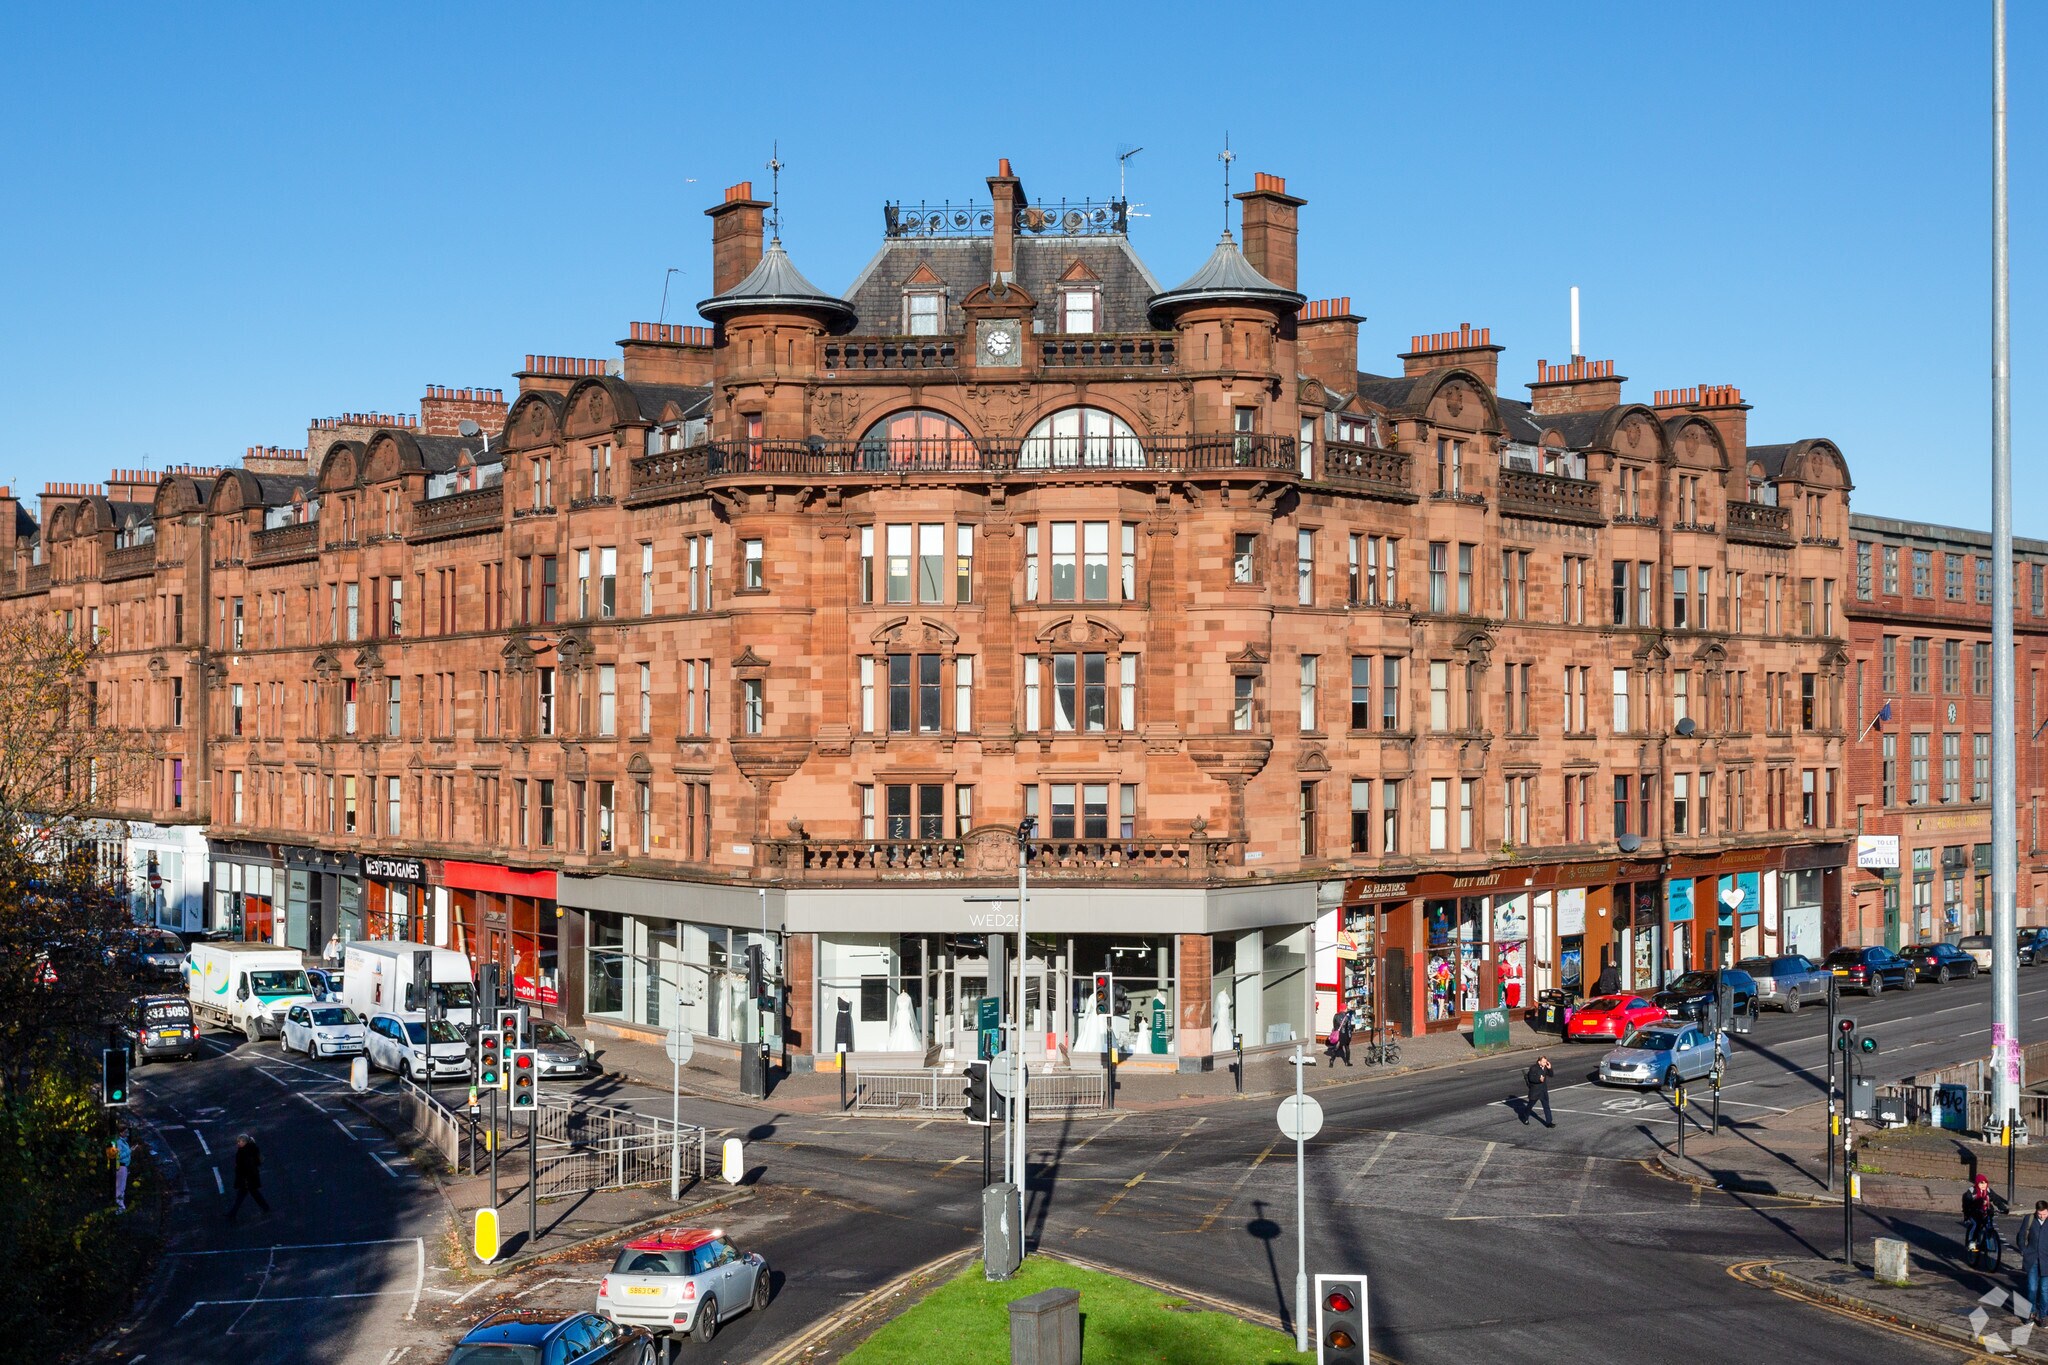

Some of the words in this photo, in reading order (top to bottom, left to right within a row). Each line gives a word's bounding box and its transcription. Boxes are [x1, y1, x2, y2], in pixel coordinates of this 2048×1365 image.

[365, 859, 382, 876] WEST
[383, 861, 397, 877] END
[396, 862, 419, 880] GAMES
[1577, 866, 1589, 874] CITY
[1589, 864, 1610, 873] GARDEN
[1453, 877, 1475, 888] ARTY
[1475, 874, 1501, 886] PARTY
[1362, 884, 1373, 894] AS
[1373, 882, 1406, 893] ELECTRICS
[630, 1287, 646, 1295] SB63
[647, 1287, 659, 1295] CMF
